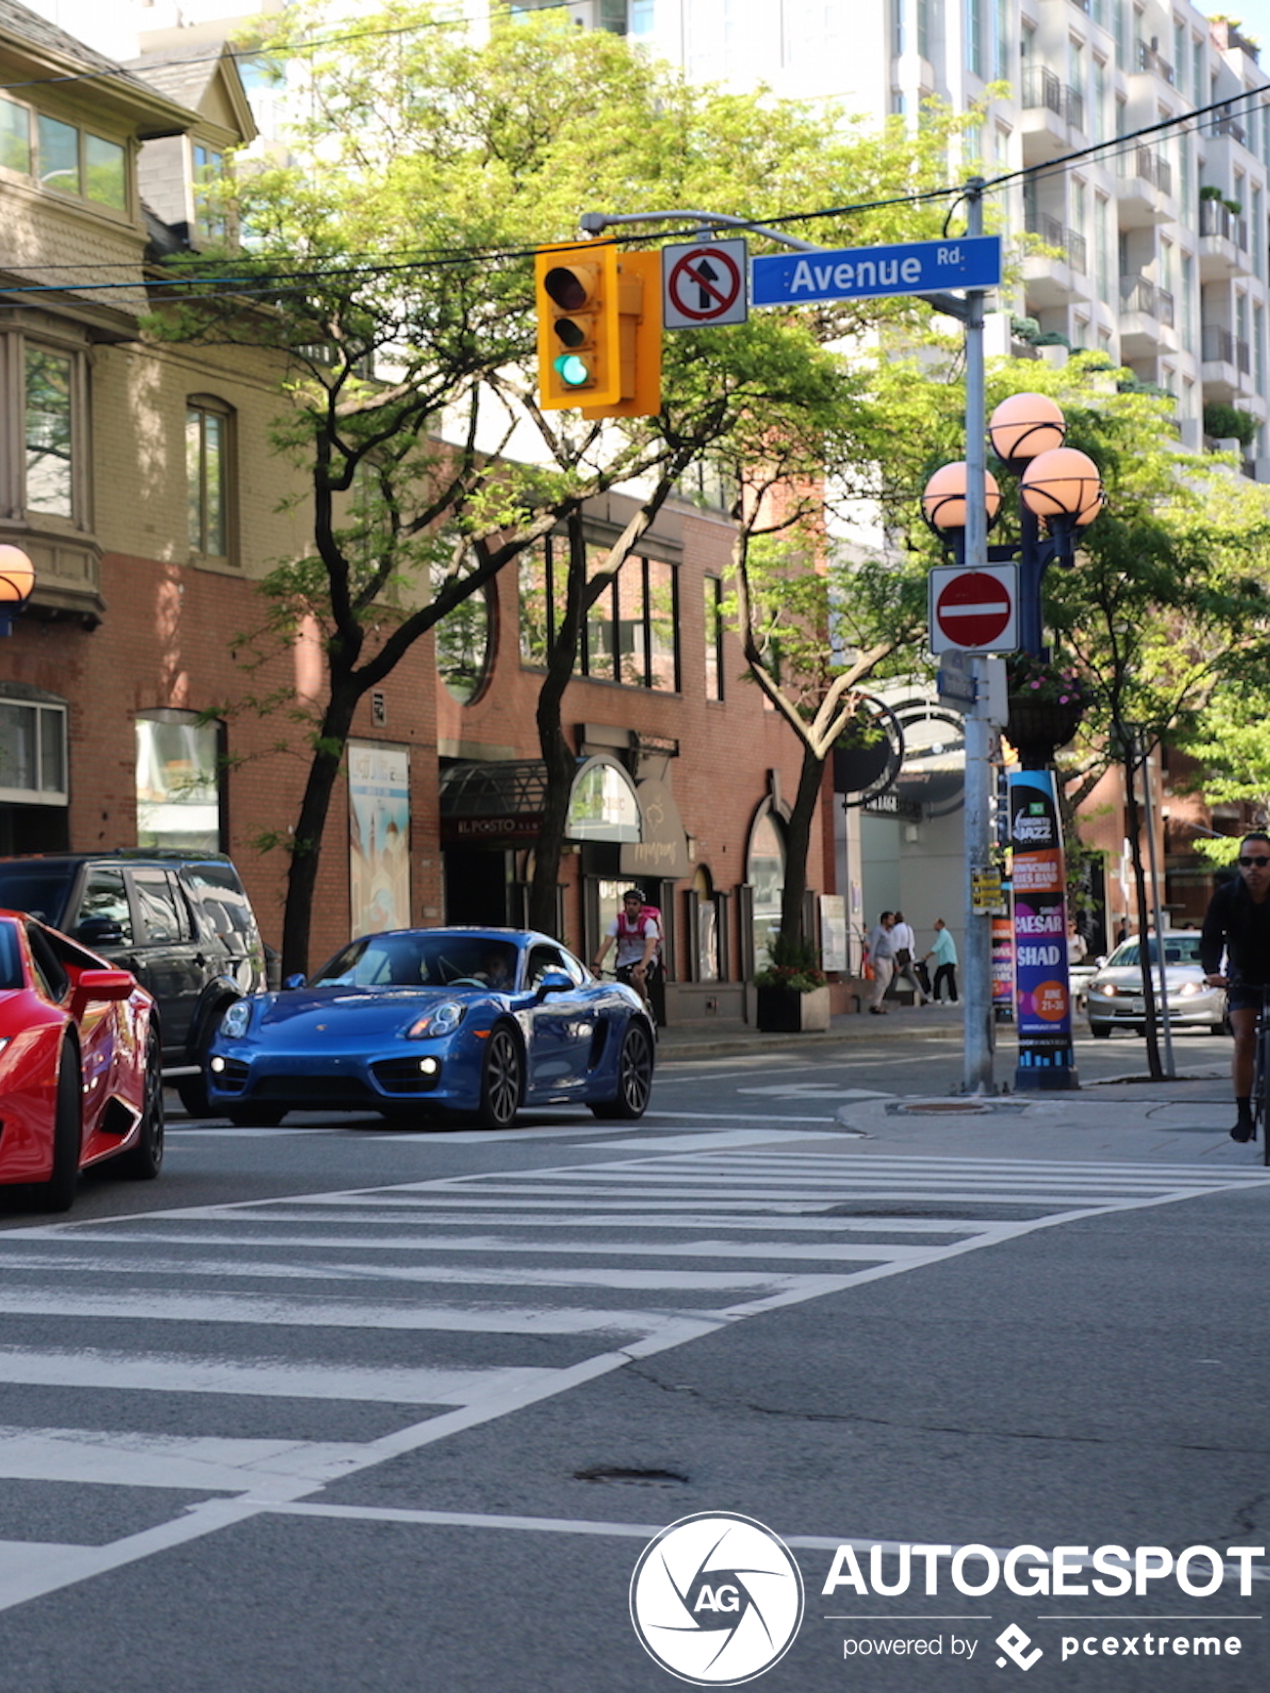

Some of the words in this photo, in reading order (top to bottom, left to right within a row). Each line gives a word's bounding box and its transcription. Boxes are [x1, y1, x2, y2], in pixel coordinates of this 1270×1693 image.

[790, 256, 923, 293] Avenue
[937, 247, 960, 265] Rd
[471, 819, 516, 833] POSTO
[1016, 915, 1062, 933] CAESAR
[1017, 945, 1060, 967] SHAD
